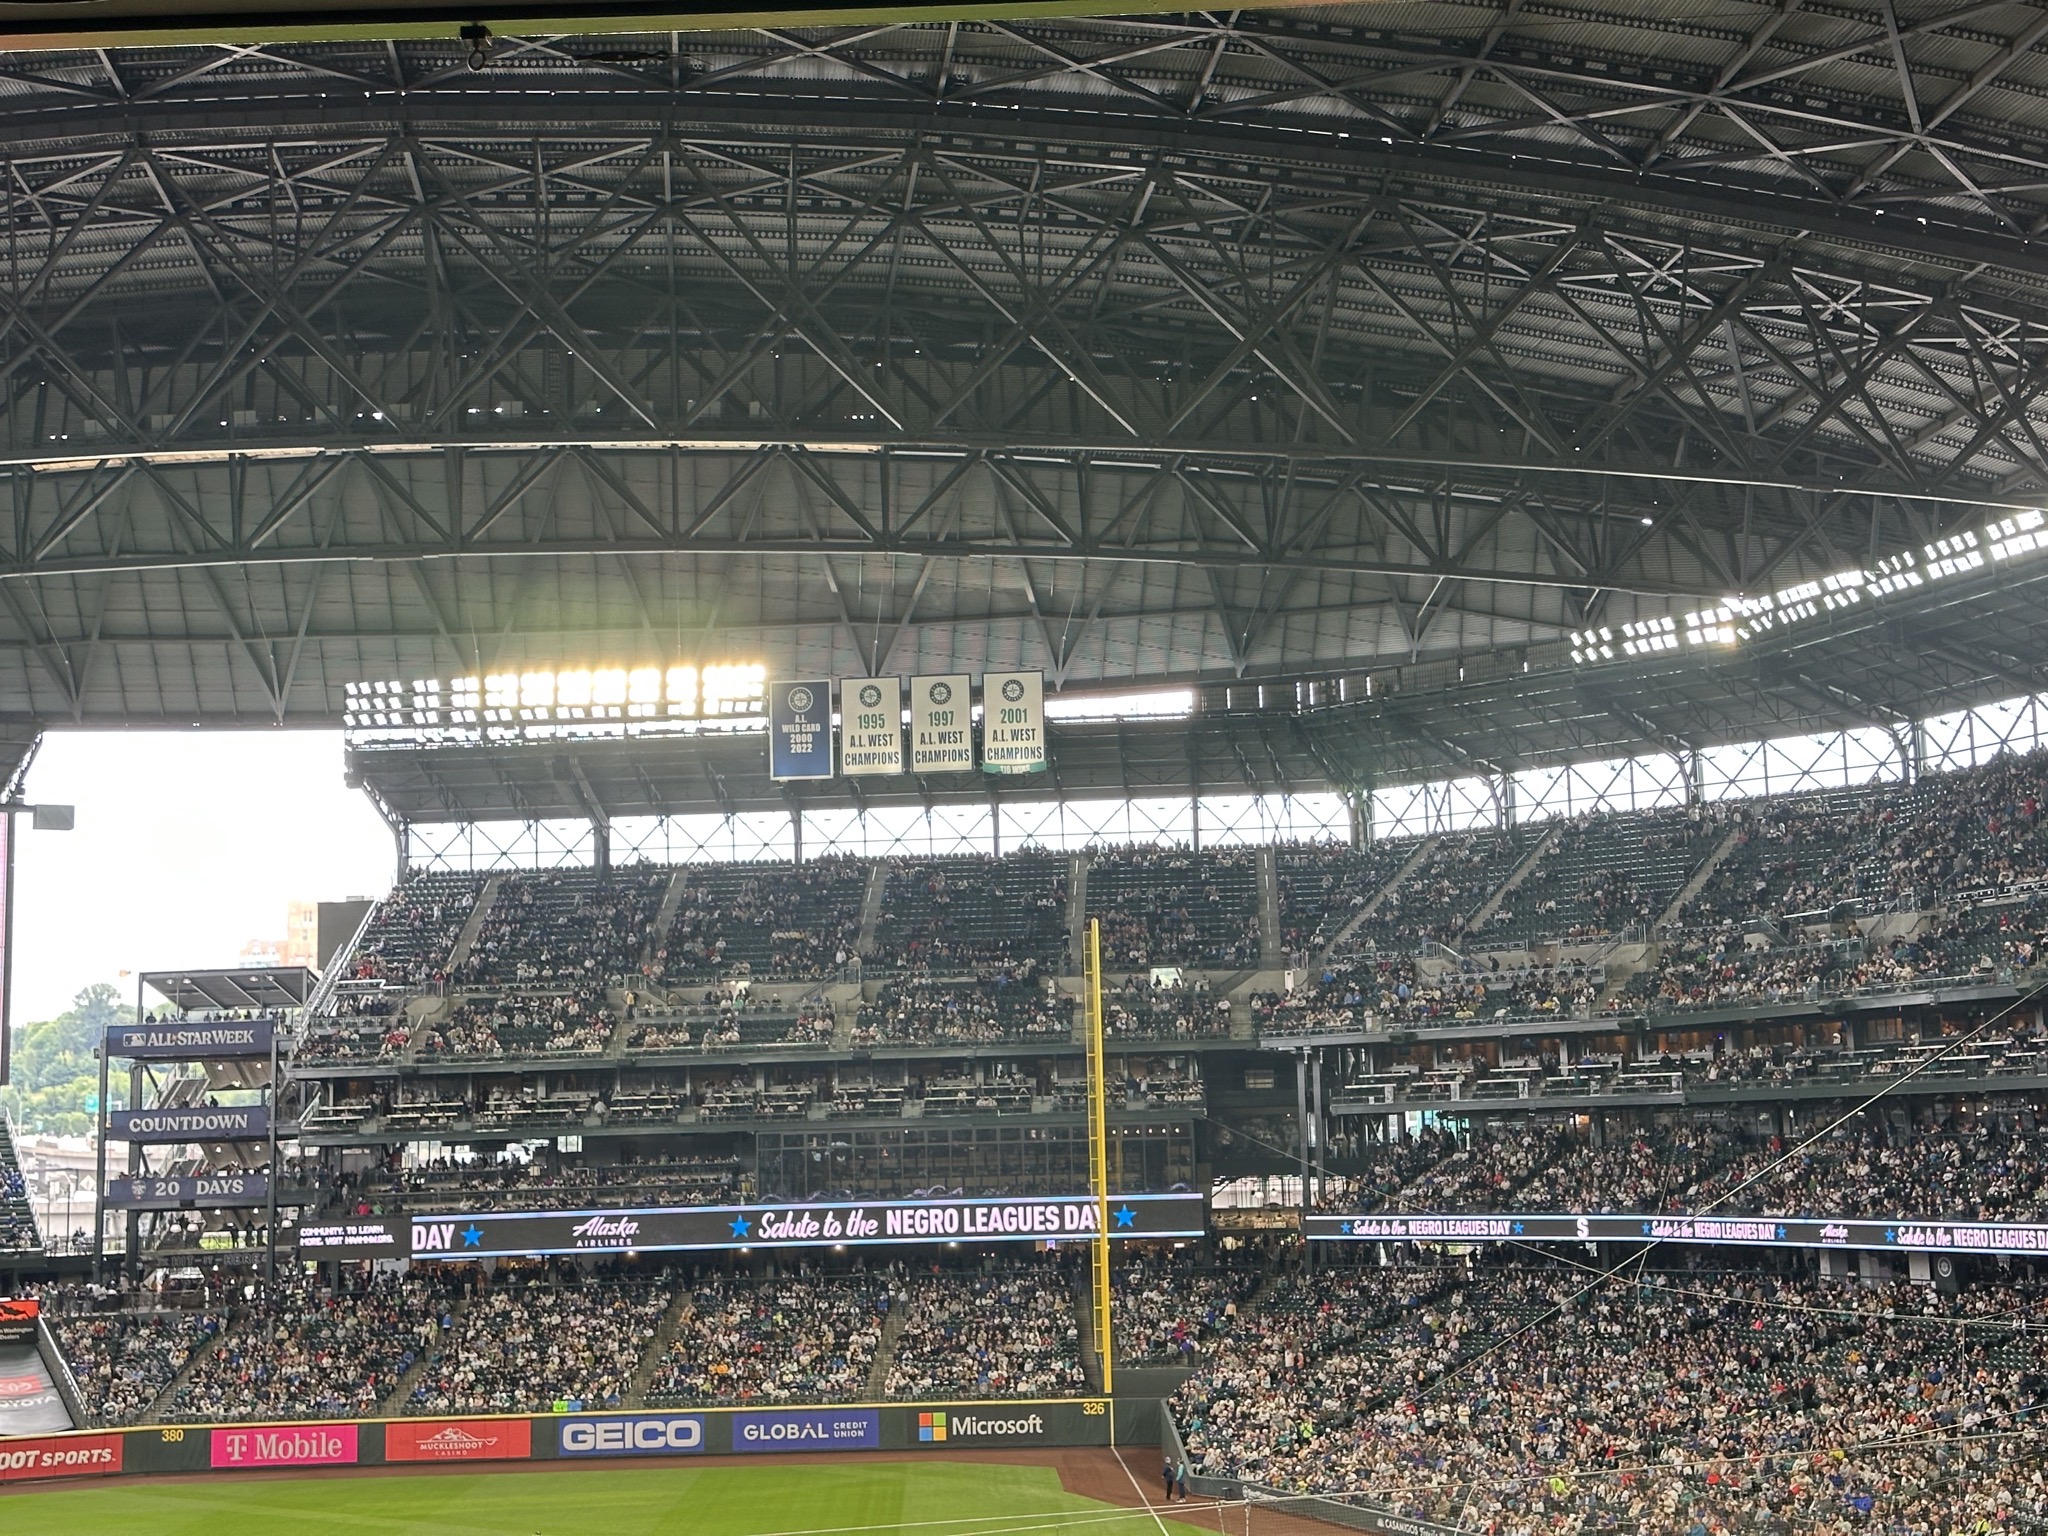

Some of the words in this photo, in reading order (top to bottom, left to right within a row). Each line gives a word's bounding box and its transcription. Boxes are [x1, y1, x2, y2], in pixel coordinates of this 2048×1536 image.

[795, 714, 807, 723] A.L.
[858, 713, 885, 729] 1995
[928, 711, 954, 727] 1997
[1000, 708, 1028, 724] 2001
[781, 724, 800, 733] WILD
[801, 723, 821, 732] CARD
[992, 729, 1008, 742] A.L.
[1010, 728, 1036, 742] WEST
[790, 733, 813, 743] 2000
[850, 735, 866, 748] A.L.
[868, 734, 894, 747] WEST
[920, 732, 936, 745] A.L.
[938, 731, 964, 744] WEST
[790, 744, 813, 754] 2022
[915, 749, 970, 763] CHAMPIONS
[987, 746, 1042, 761] CHAMPIONS
[844, 751, 900, 766] CHAMPIONS
[177, 1031, 212, 1046] STAR
[211, 1030, 254, 1044] WEEK
[129, 1113, 248, 1132] COUNTDOWN
[155, 1181, 180, 1196] 20
[196, 1179, 244, 1195] DAYS
[572, 1216, 637, 1237] Alaska
[758, 1211, 820, 1239] Salute
[822, 1212, 842, 1238] to
[845, 1209, 879, 1237] the
[886, 1207, 960, 1236] NEGRO
[963, 1204, 1060, 1234] LEAGUES
[1352, 1220, 1380, 1236] Salute
[1381, 1220, 1390, 1235] to
[1391, 1219, 1407, 1236] the
[1408, 1221, 1442, 1236] NEGRO
[1443, 1220, 1488, 1236] LEAGUES
[1489, 1221, 1511, 1236] DAY
[1576, 1217, 1589, 1239] S
[346, 1226, 357, 1235] TO
[358, 1225, 384, 1235] LEARN
[412, 1224, 455, 1251] DAY
[1694, 1222, 1721, 1239] NEGRO
[1721, 1222, 1758, 1240] LEAGUES
[1758, 1223, 1776, 1240] DAY
[1897, 1226, 1925, 1245] Salute
[1926, 1227, 1935, 1246] to
[1936, 1226, 1952, 1246] the
[1953, 1228, 1989, 1248] NEGRO
[1989, 1229, 2037, 1249] LEAGUES
[325, 1236, 343, 1246] VISIT
[576, 1238, 633, 1248] AIRLINES
[1082, 1402, 1105, 1415] 326
[743, 1422, 829, 1441] GLOBAL
[833, 1421, 868, 1431] CREDIT
[952, 1414, 1043, 1436] Microsoft
[161, 1429, 184, 1443] 380
[563, 1419, 700, 1451] GEICO
[833, 1430, 864, 1438] UNION
[255, 1431, 343, 1459] Mobile
[420, 1442, 483, 1450] MUCKLESHOOT
[40, 1448, 112, 1467] SPORTS
[1384, 1518, 1418, 1535] CASAMIGOS
